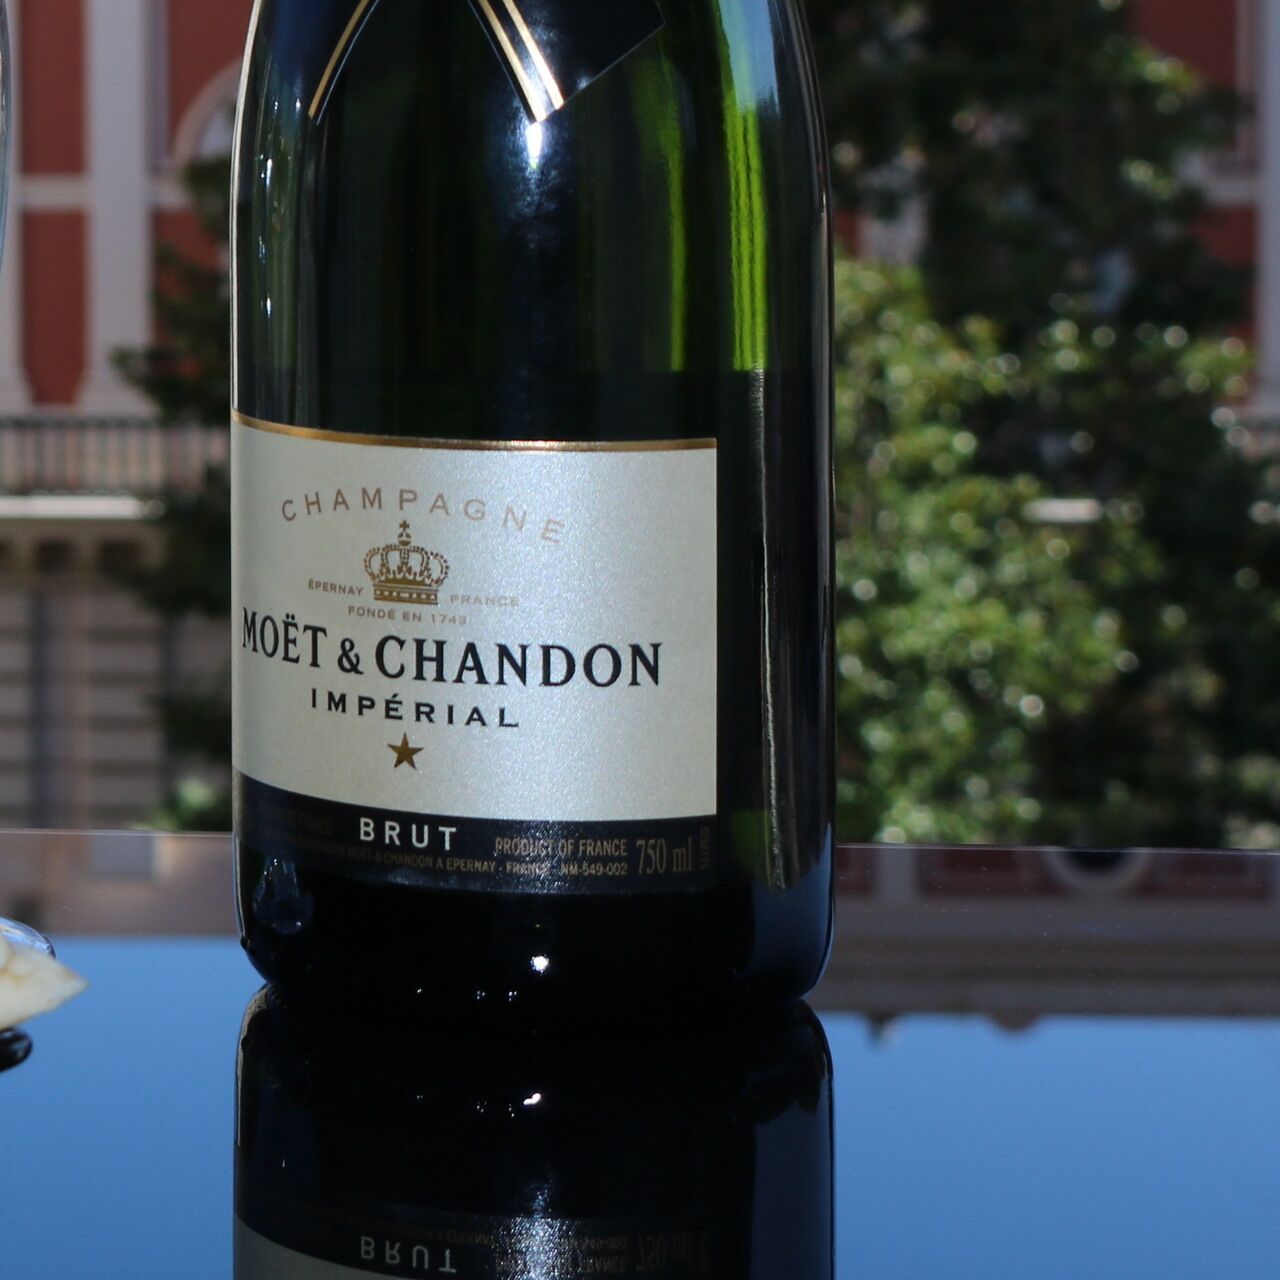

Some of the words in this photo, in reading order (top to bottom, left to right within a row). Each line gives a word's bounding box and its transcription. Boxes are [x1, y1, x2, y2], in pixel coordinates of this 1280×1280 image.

[282, 487, 565, 545] CHAMPAGNE
[307, 579, 364, 596] ÉPERNAY
[449, 593, 520, 607] FRANCE
[347, 605, 396, 620] FONDÉ
[402, 610, 423, 622] EN
[430, 613, 467, 625] 1743
[242, 608, 327, 668] MOËT
[337, 637, 364, 675] &
[374, 635, 662, 688] CHANDON
[311, 688, 519, 728] IMPÉRIAL
[359, 817, 456, 851] BRUT
[495, 837, 555, 857] PRODUCT
[559, 838, 575, 856] OF
[579, 838, 628, 857] FRANCE
[446, 856, 496, 873] EPERNAY
[636, 837, 667, 875] 750
[671, 836, 694, 873] ml
